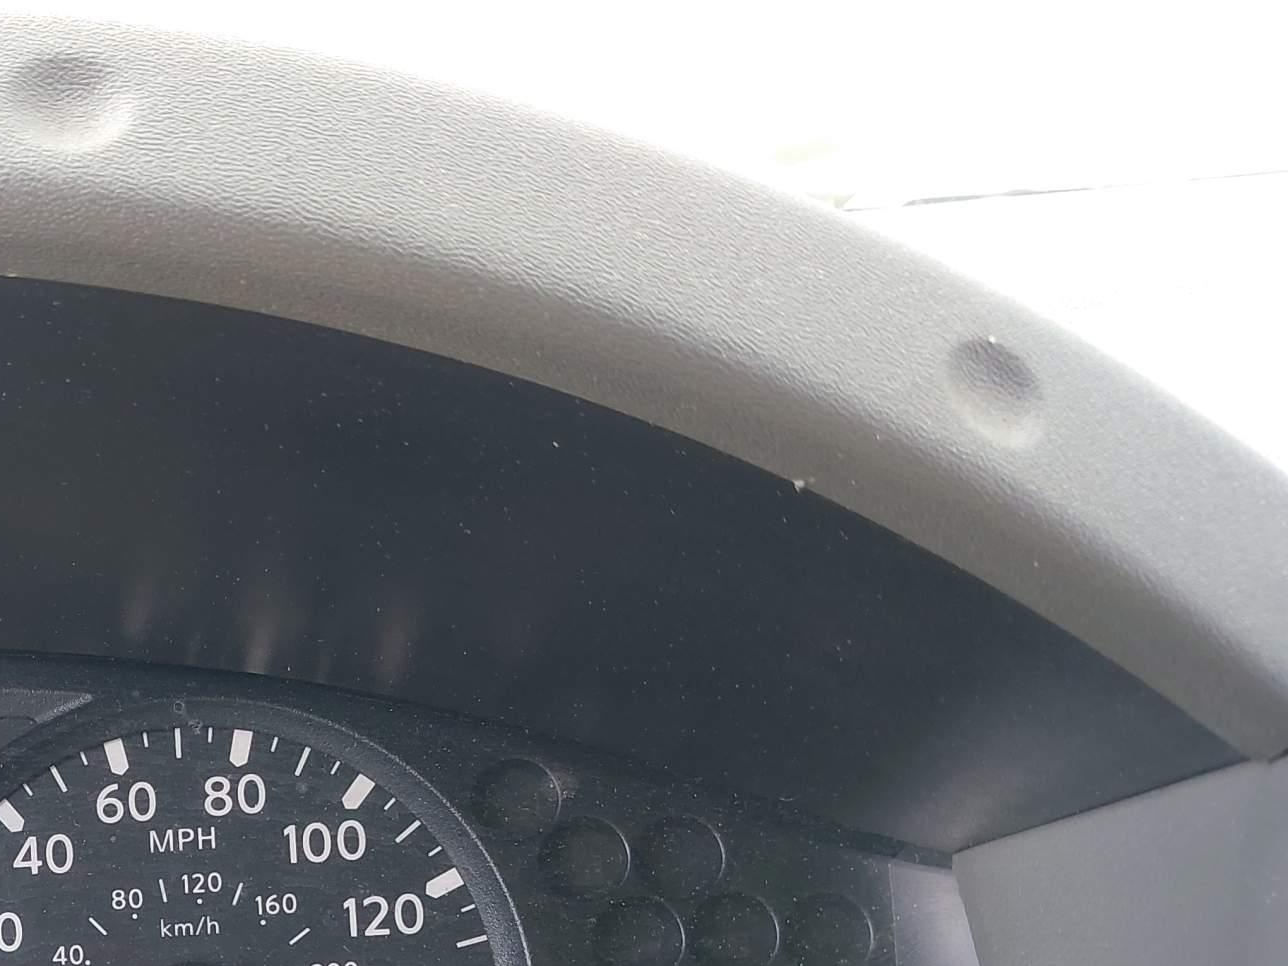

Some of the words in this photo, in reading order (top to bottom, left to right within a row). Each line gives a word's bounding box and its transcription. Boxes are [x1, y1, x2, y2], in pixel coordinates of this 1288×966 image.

[96, 782, 156, 823] 60
[204, 775, 266, 815] 80
[13, 834, 73, 875] 40
[149, 827, 216, 853] MPH
[283, 820, 367, 863] 100
[111, 889, 143, 909] 80
[180, 873, 222, 893] 120
[255, 895, 297, 914] 160
[343, 893, 424, 937] 120
[159, 917, 220, 938] km/h
